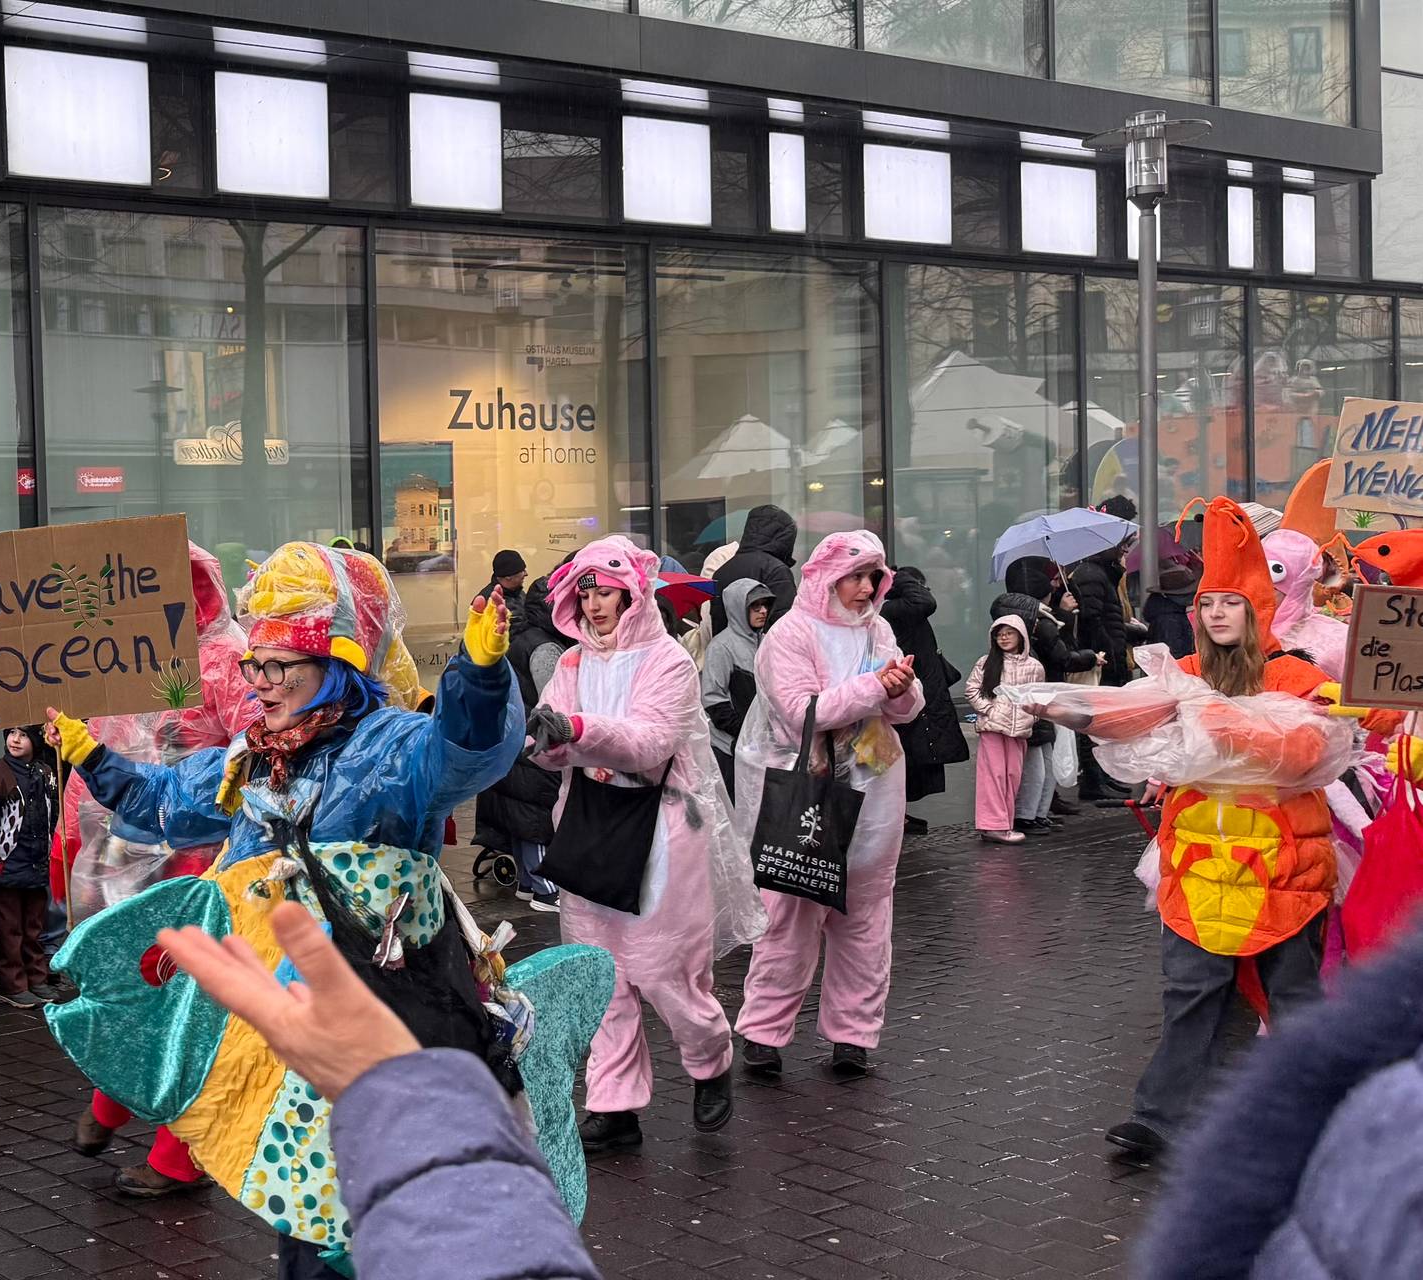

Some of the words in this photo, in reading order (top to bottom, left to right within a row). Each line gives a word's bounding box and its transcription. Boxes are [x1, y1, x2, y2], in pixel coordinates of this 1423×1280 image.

[526, 344, 561, 355] OSTHAUS
[562, 346, 595, 357] MUSEUM
[545, 357, 571, 367] HAGEN
[448, 387, 596, 431] Zuhause
[519, 443, 537, 464] at
[543, 437, 596, 464] home
[100, 553, 161, 605] the
[1361, 636, 1391, 657] die
[759, 854, 840, 883] SPEZIALITÄTEN
[762, 844, 841, 873] MÄRKISCHE
[756, 863, 839, 893] BRENNEREI
